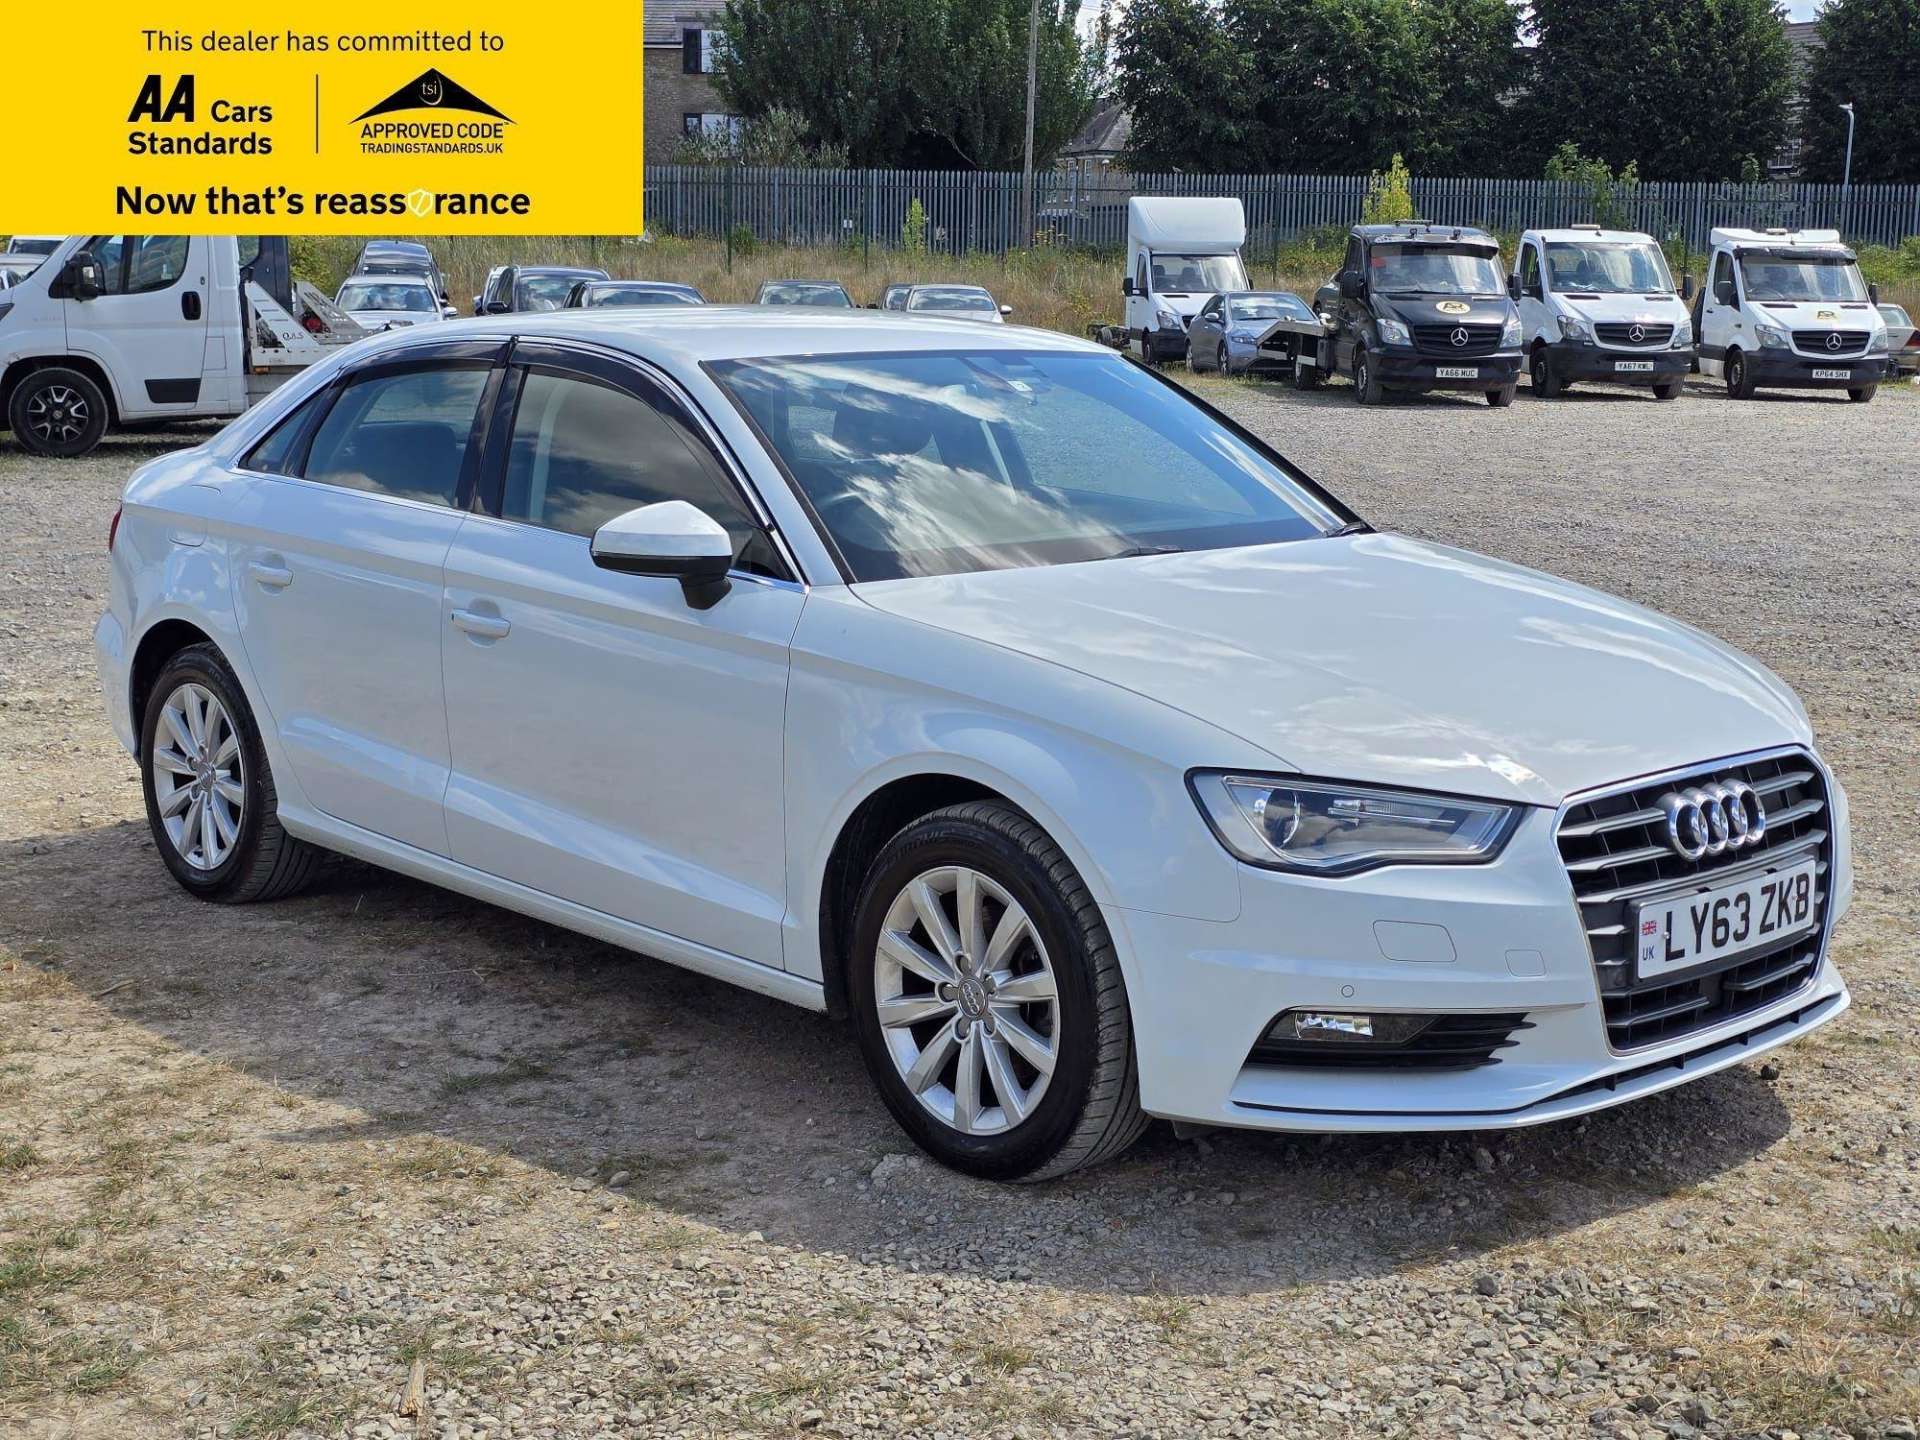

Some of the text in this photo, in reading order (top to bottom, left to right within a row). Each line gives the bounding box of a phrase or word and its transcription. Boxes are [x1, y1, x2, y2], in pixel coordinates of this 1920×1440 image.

[1440, 369, 1460, 377] YA66
[1665, 873, 1810, 961] LY63 ZKB
[1642, 946, 1655, 961] UK
